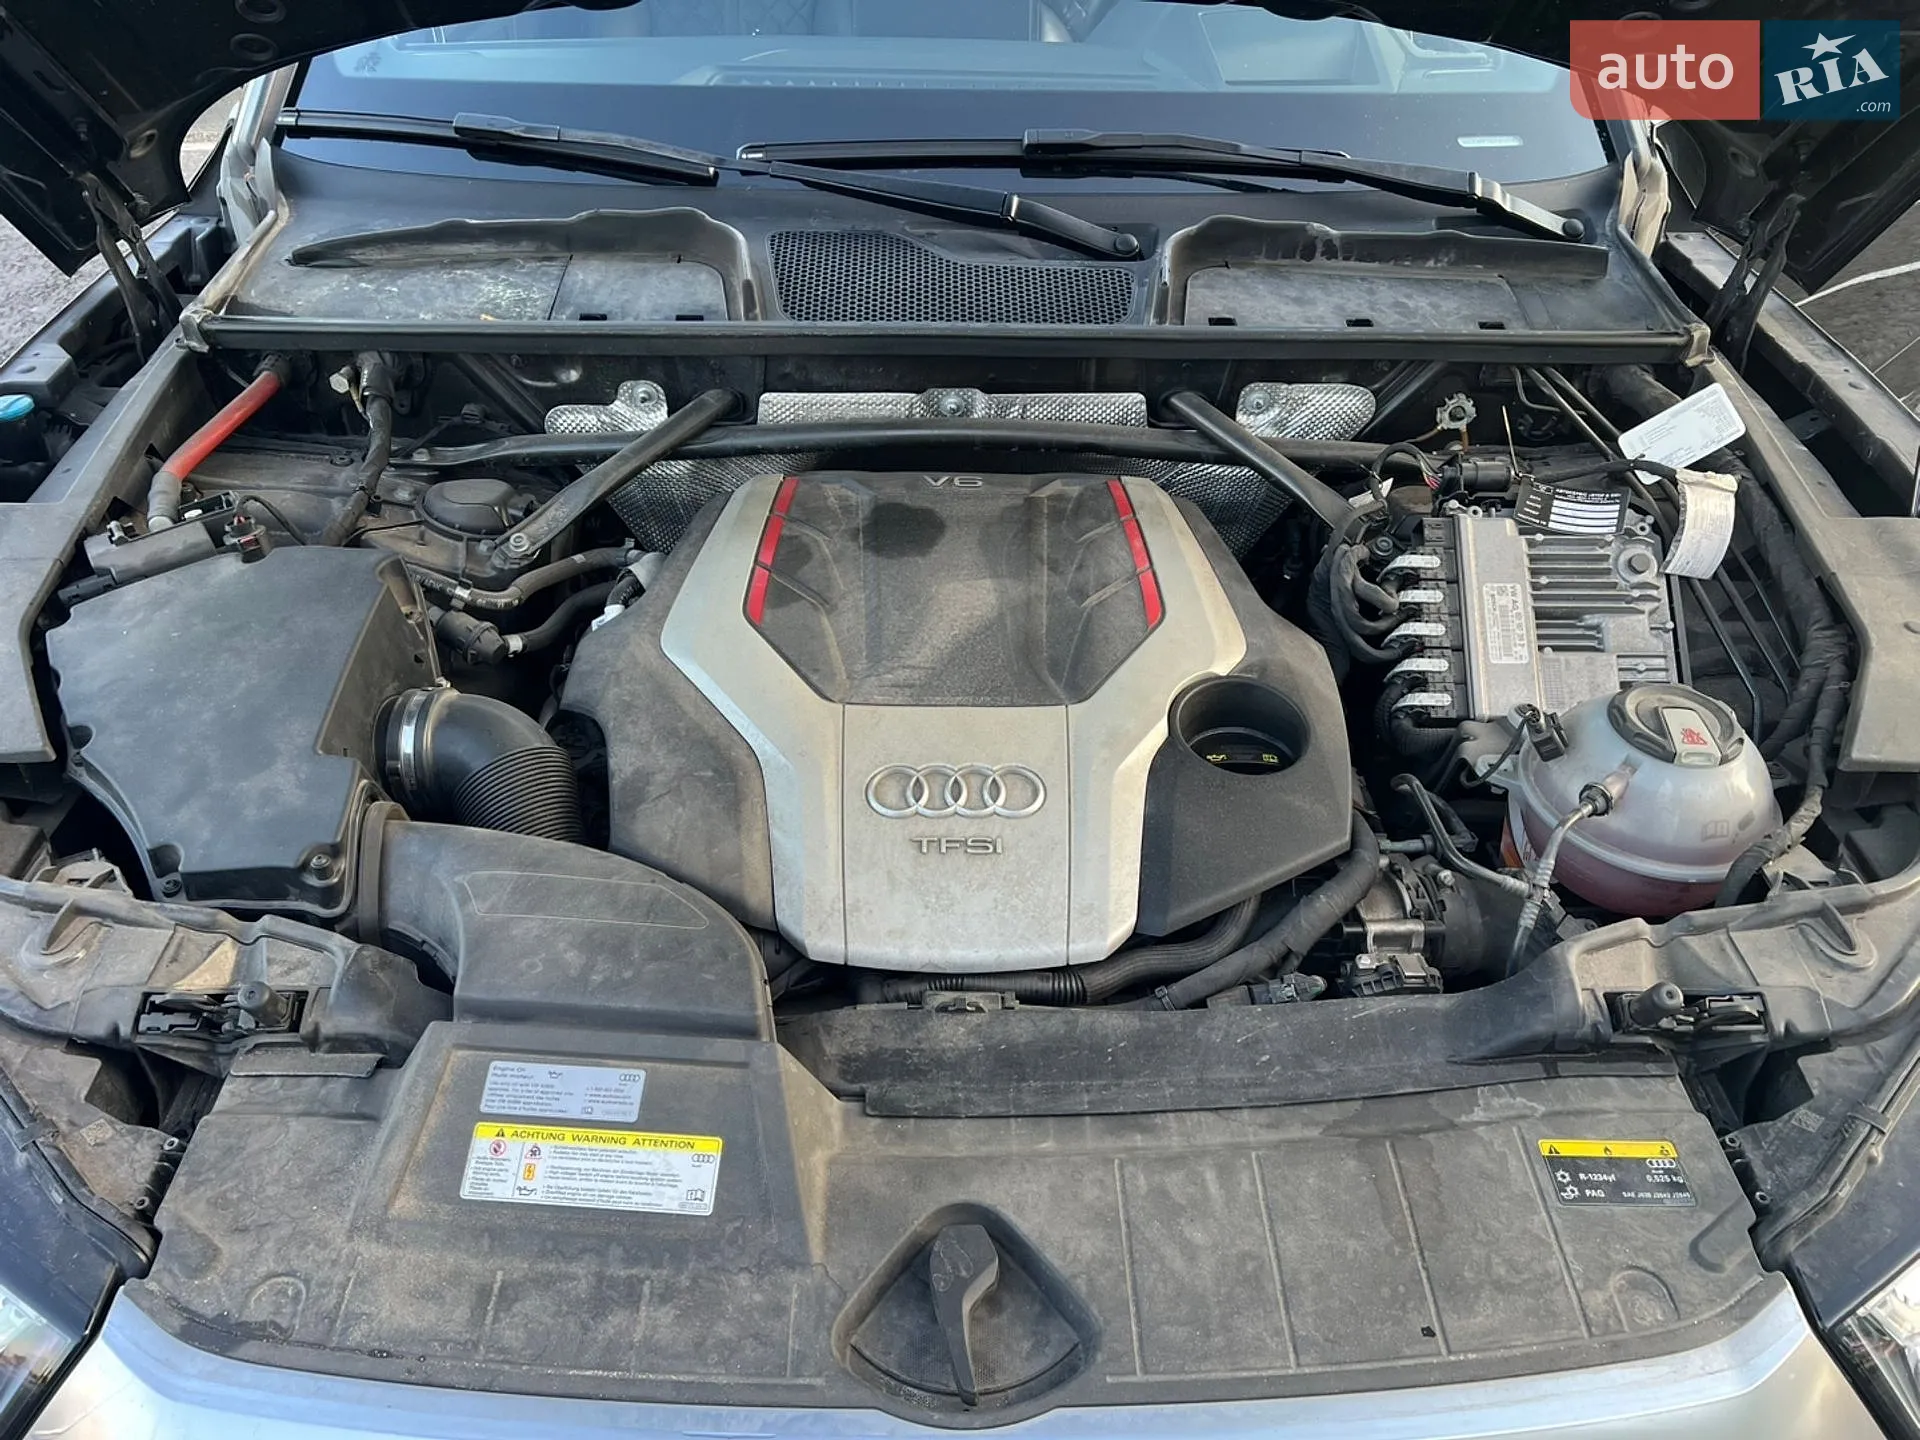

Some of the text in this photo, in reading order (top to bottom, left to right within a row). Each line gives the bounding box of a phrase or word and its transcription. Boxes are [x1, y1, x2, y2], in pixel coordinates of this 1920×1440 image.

[923, 475, 983, 489] V6
[910, 836, 1003, 854] TFSI
[511, 1130, 565, 1142] ACHTUNG
[571, 1133, 627, 1146] WARNING
[632, 1137, 695, 1150] ATTENTION
